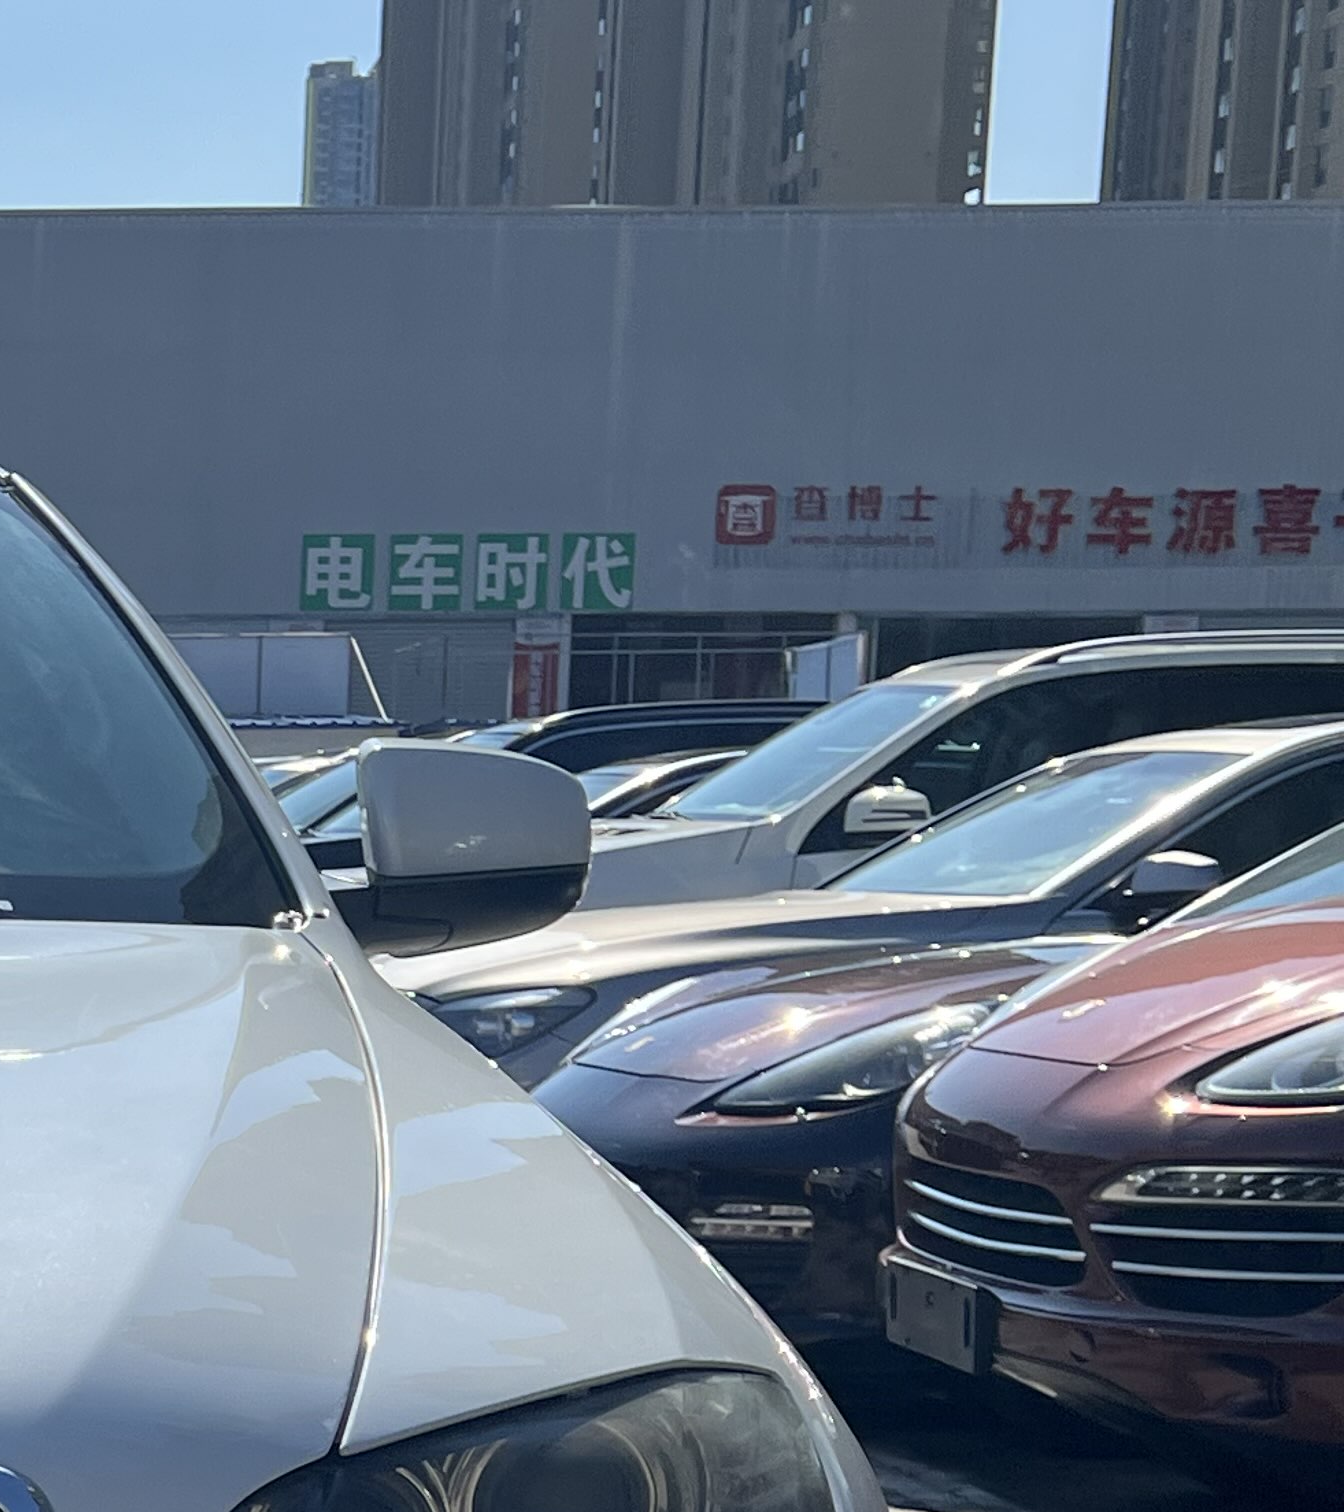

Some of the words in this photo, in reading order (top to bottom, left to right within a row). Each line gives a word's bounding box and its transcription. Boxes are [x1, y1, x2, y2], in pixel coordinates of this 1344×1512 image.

[1002, 484, 1344, 555] 好车源喜
[306, 536, 631, 610] 电车时代
